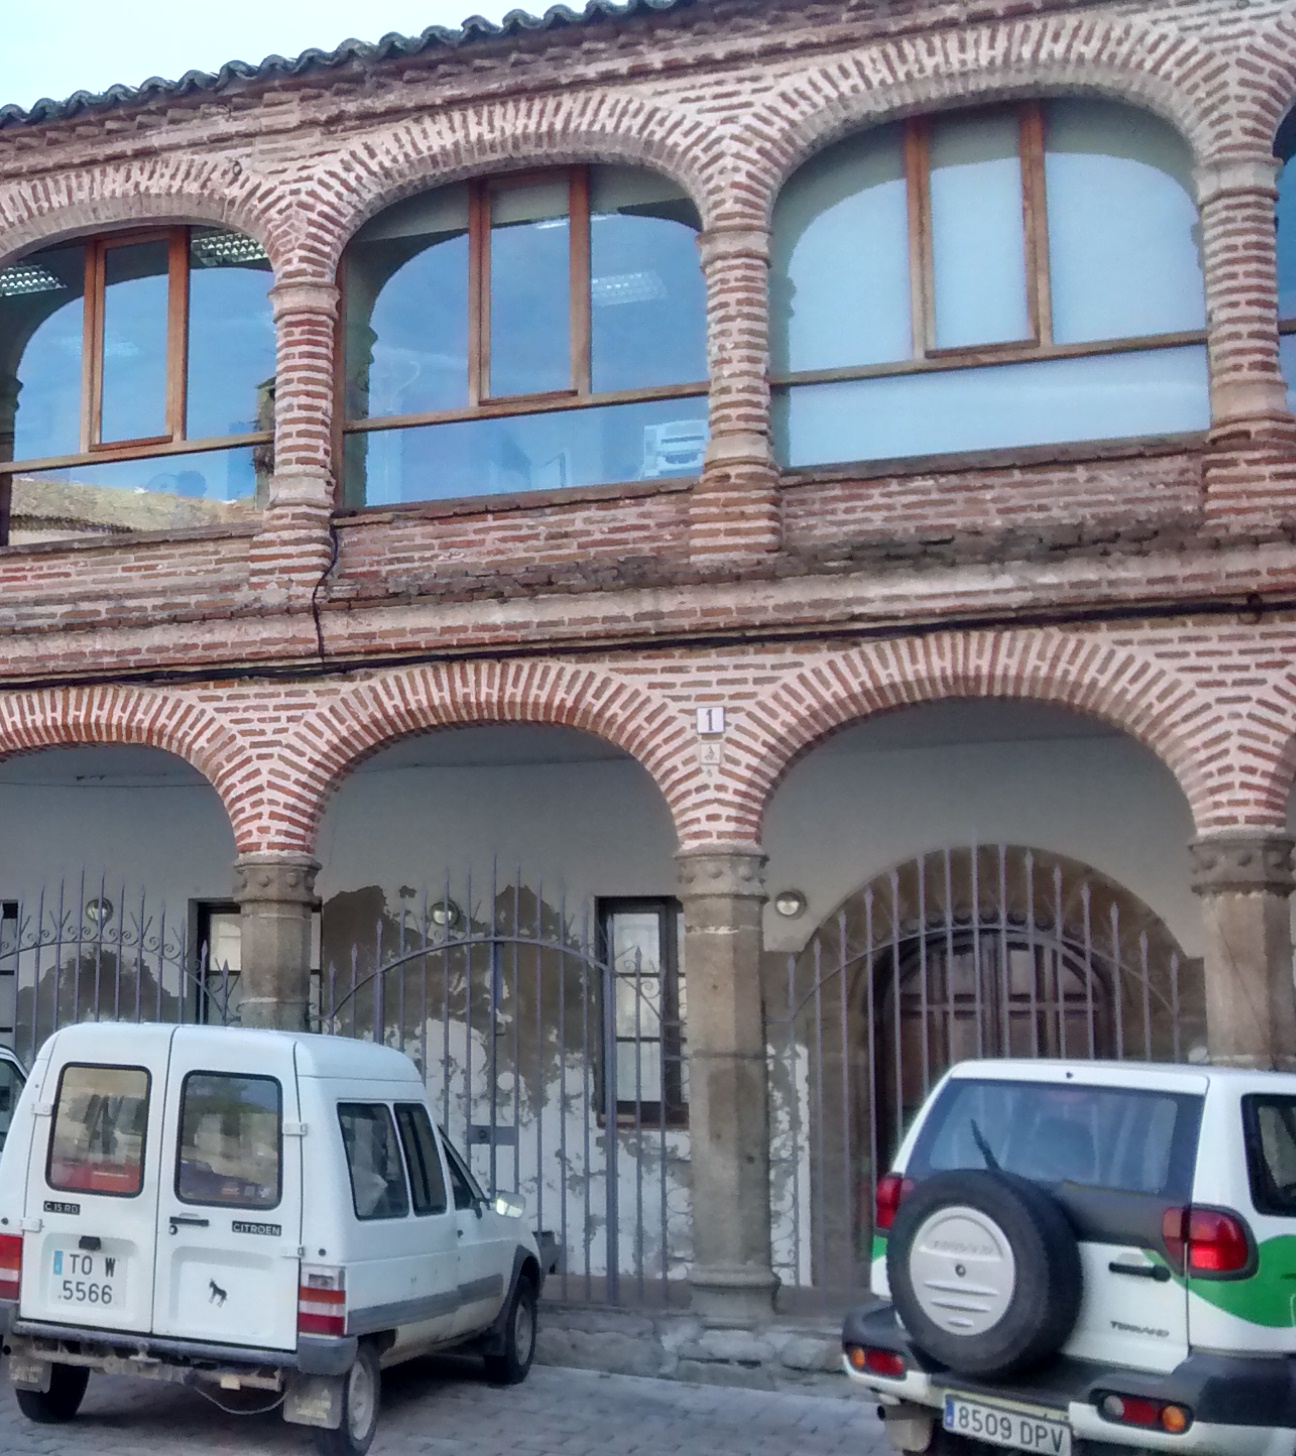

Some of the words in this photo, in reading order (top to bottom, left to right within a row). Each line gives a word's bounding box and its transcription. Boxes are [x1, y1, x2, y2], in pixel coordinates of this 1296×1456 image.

[705, 709, 714, 731] 1
[233, 1223, 280, 1235] CITROEN
[69, 1253, 93, 1276] TO
[105, 1256, 116, 1278] W
[62, 1279, 113, 1305] 5566
[958, 1406, 1012, 1440] 8509
[1020, 1421, 1064, 1453] DPV
